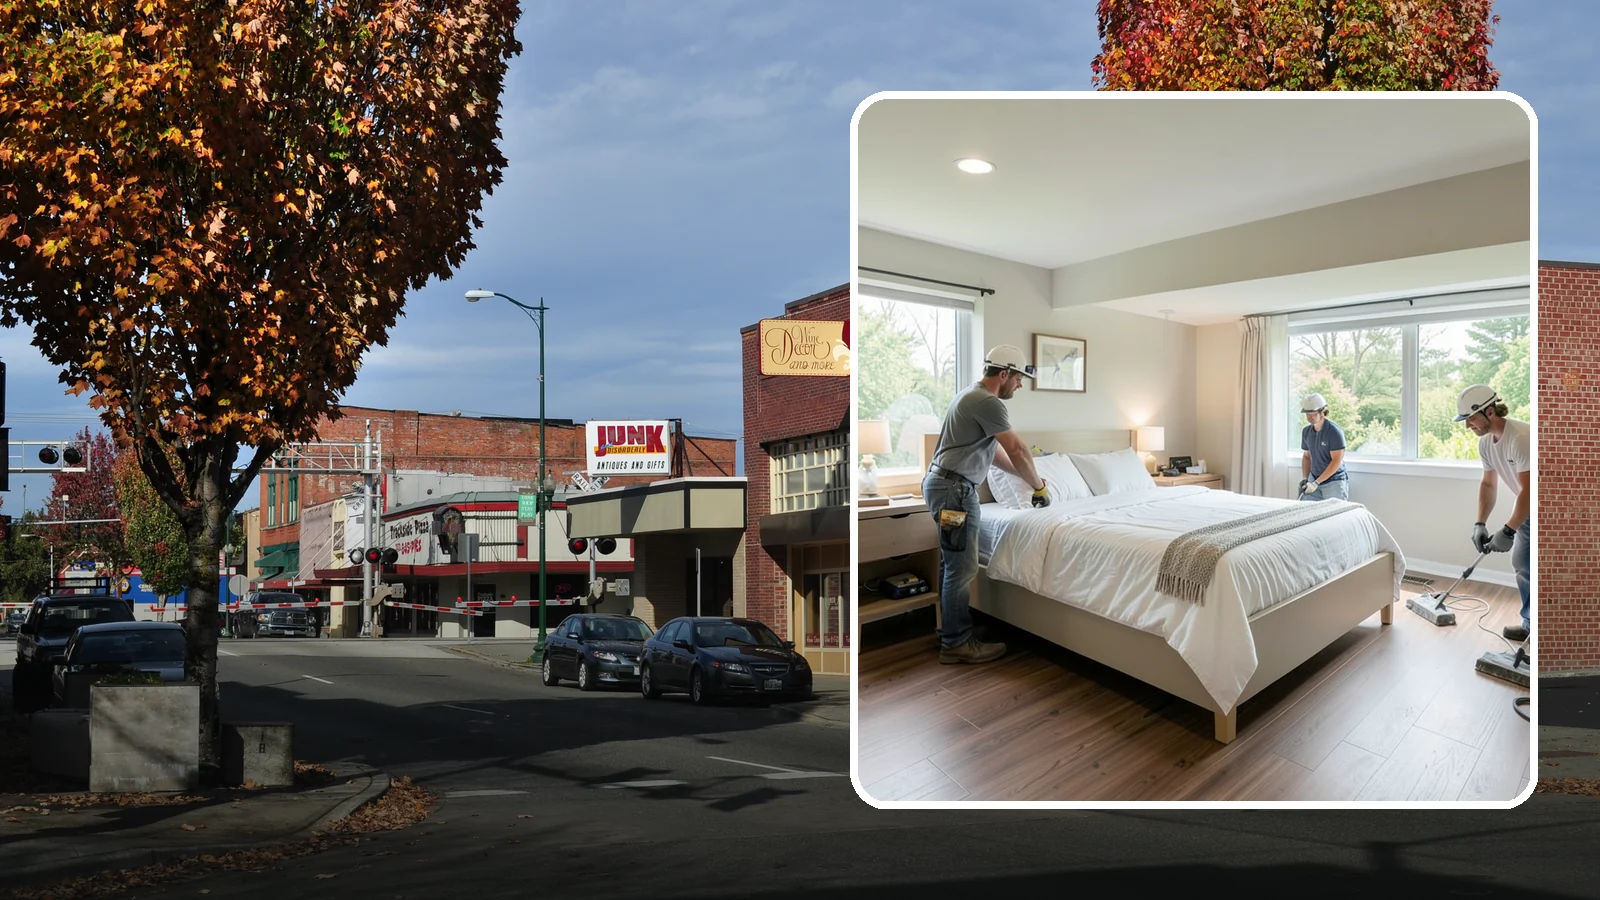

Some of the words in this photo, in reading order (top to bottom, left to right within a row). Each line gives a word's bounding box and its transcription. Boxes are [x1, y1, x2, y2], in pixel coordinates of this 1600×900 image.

[596, 425, 665, 457] JUNK
[607, 446, 646, 454] DISORDERLY
[597, 461, 628, 470] ANTIQUES
[631, 461, 643, 470] AND
[647, 460, 665, 470] GIFTS
[390, 521, 413, 539] Trackside
[415, 519, 429, 535] Pizza
